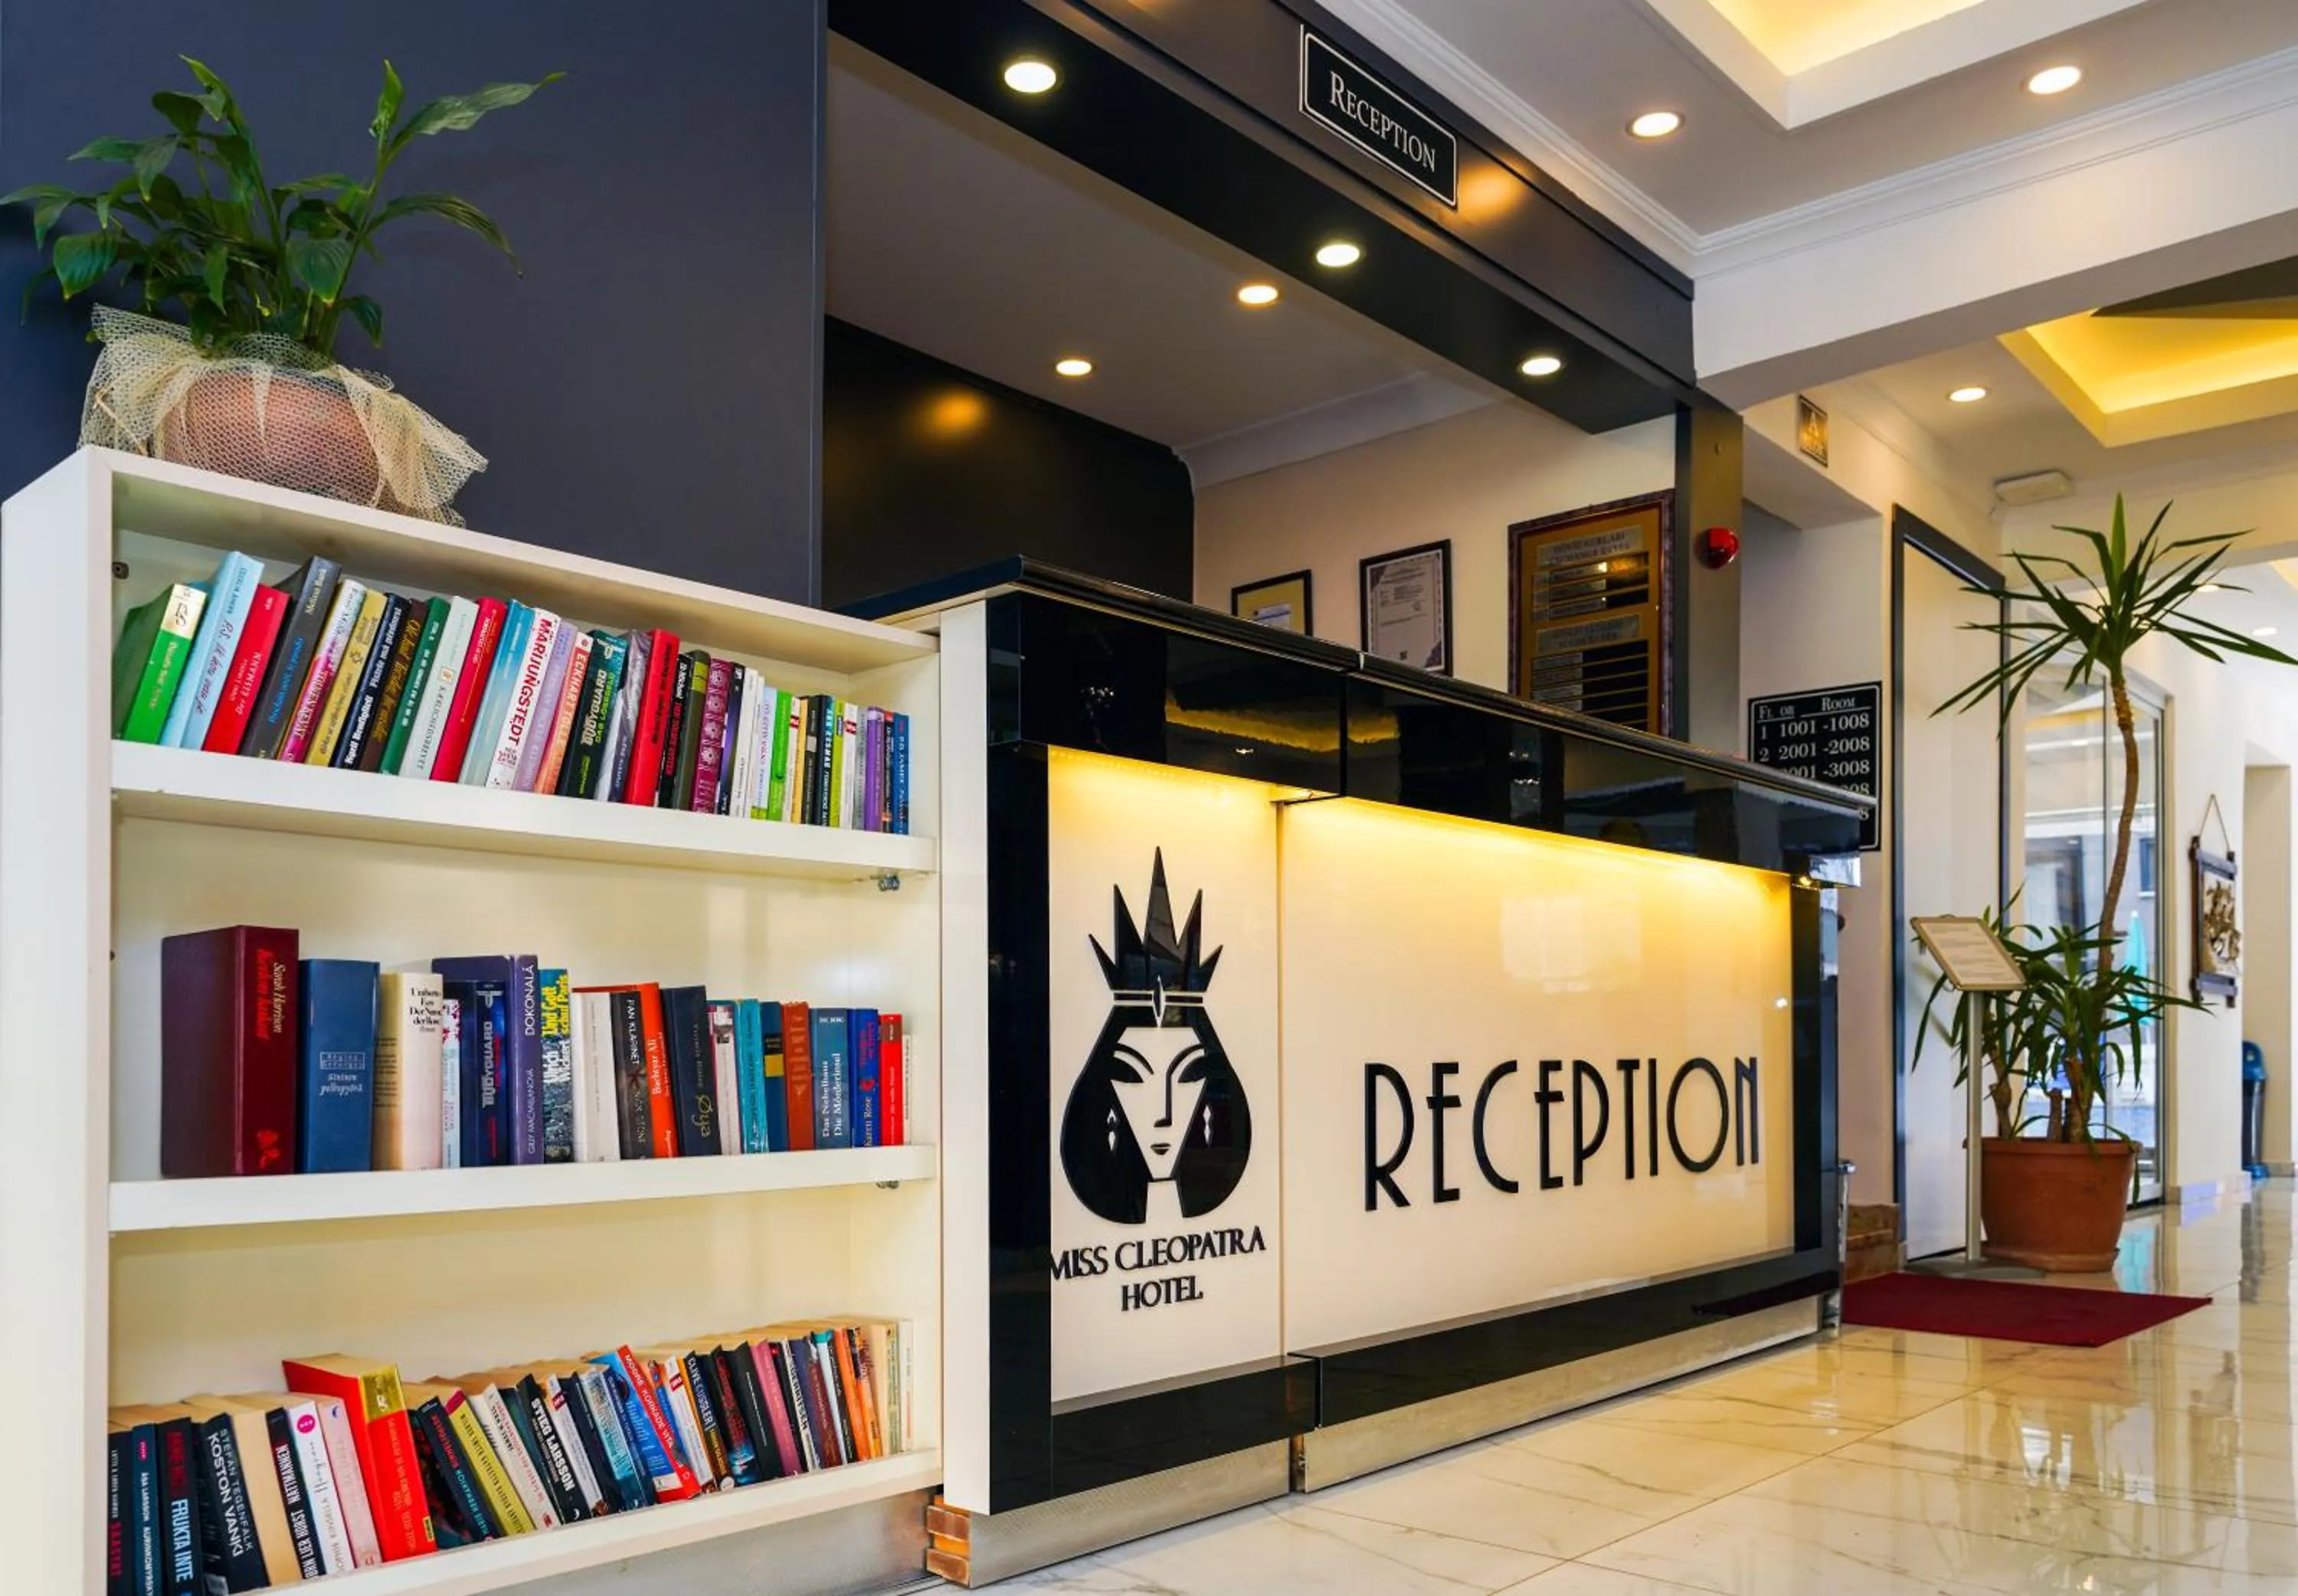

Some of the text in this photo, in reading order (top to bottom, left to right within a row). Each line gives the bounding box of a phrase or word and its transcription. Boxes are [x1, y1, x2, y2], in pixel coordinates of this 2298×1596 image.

[1330, 70, 1436, 172] RECEPTION
[561, 651, 590, 708] ECKHART
[578, 668, 613, 747] BODYGUARD
[1760, 737, 1871, 762] 2 2001 -2008
[1761, 713, 1870, 740] 1 1001 -1008
[1779, 759, 1870, 779] 001 -3008
[271, 962, 286, 1033] Sarah Harrison
[522, 964, 535, 1035] DOKONALÁ
[542, 985, 558, 1035] Und Gott
[557, 973, 569, 1002] Paris
[482, 1021, 495, 1107] BODYGUARD
[543, 1049, 558, 1083] Ulrich
[626, 1022, 640, 1065] KLARINET
[689, 1094, 714, 1138] Øya
[831, 1053, 842, 1136] Die Mörderinsel
[863, 1096, 872, 1117] Rose
[1364, 1057, 1760, 1212] RECEPTION
[1050, 1225, 1266, 1280] MISS CLEOPATRA
[1121, 1275, 1203, 1312] HOTEL
[623, 1353, 645, 1387] MOORE
[640, 1387, 666, 1430] KORKADE
[660, 1428, 676, 1448] VITA
[686, 1356, 715, 1424] CLIVE CUSSLER
[275, 1443, 300, 1504] NATTMANNEN
[529, 1396, 576, 1492] STIEG LARSSON
[206, 1432, 244, 1558] KOSTON VANKI
[219, 1428, 254, 1551] STEFAN TEGENFALK
[169, 1498, 192, 1582] FRUKTA INTE
[290, 1509, 308, 1538] HORST
